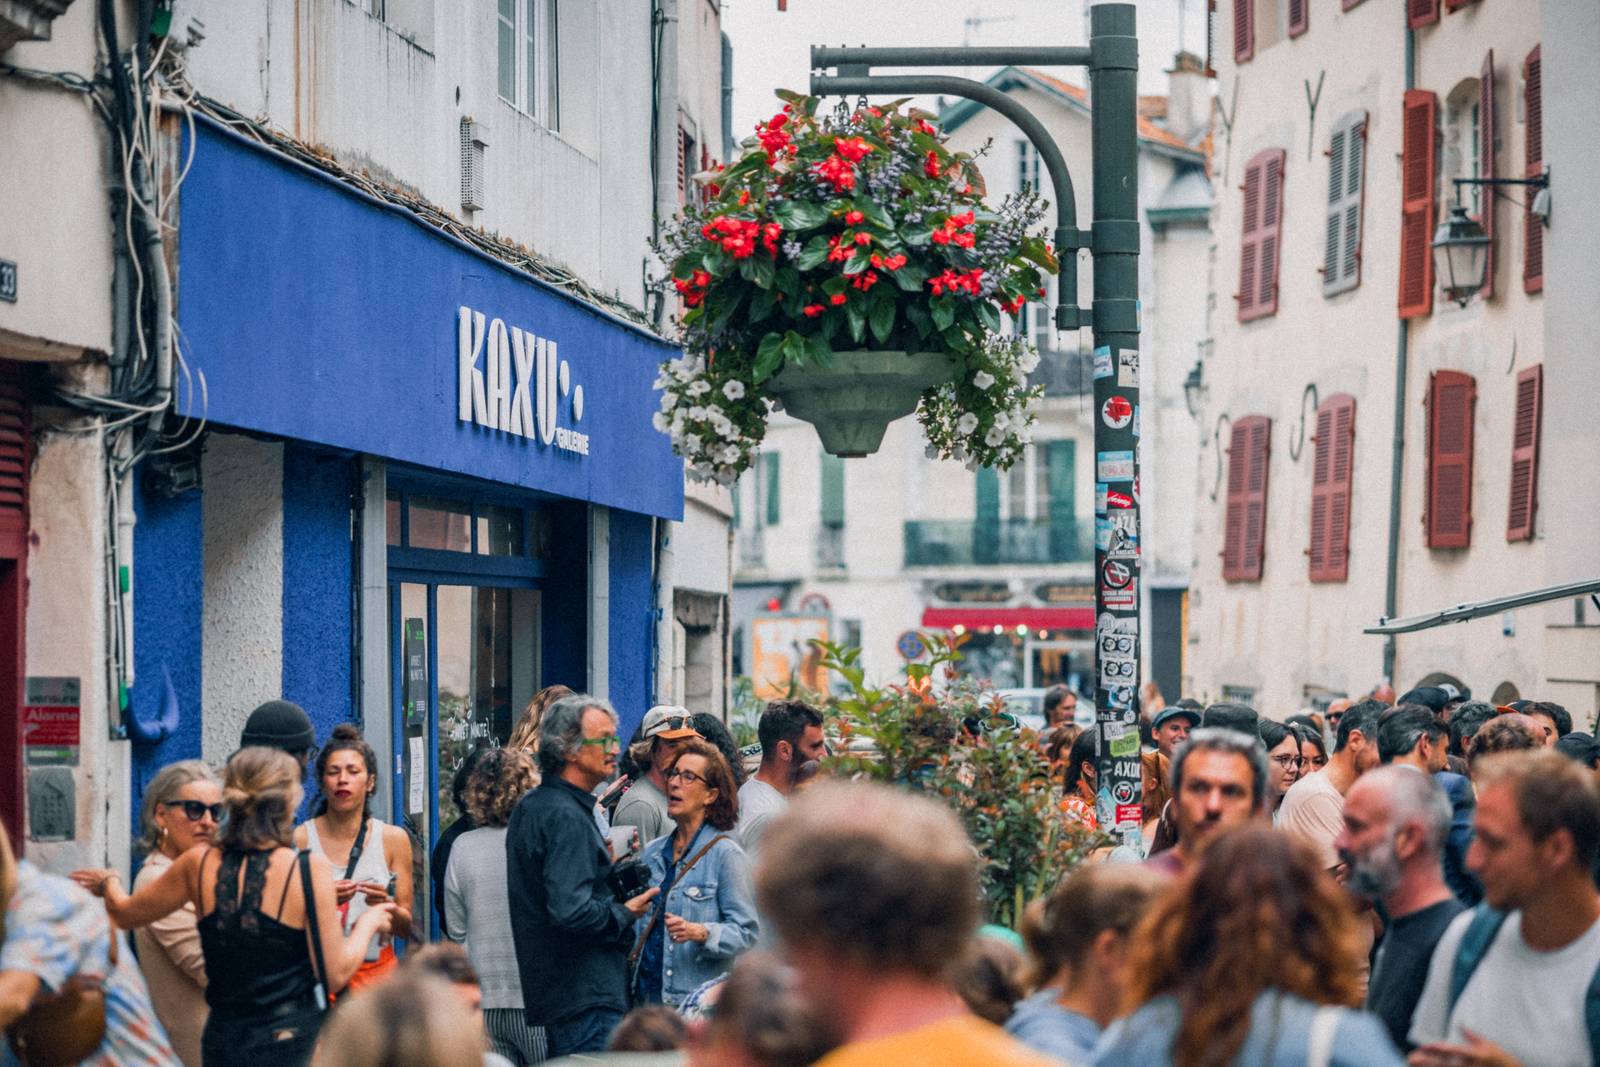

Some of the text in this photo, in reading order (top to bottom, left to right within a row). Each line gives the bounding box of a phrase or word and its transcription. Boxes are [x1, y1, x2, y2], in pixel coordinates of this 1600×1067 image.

[459, 305, 557, 445] KAXU
[556, 427, 589, 456] GALERIE
[28, 709, 78, 721] Alarme
